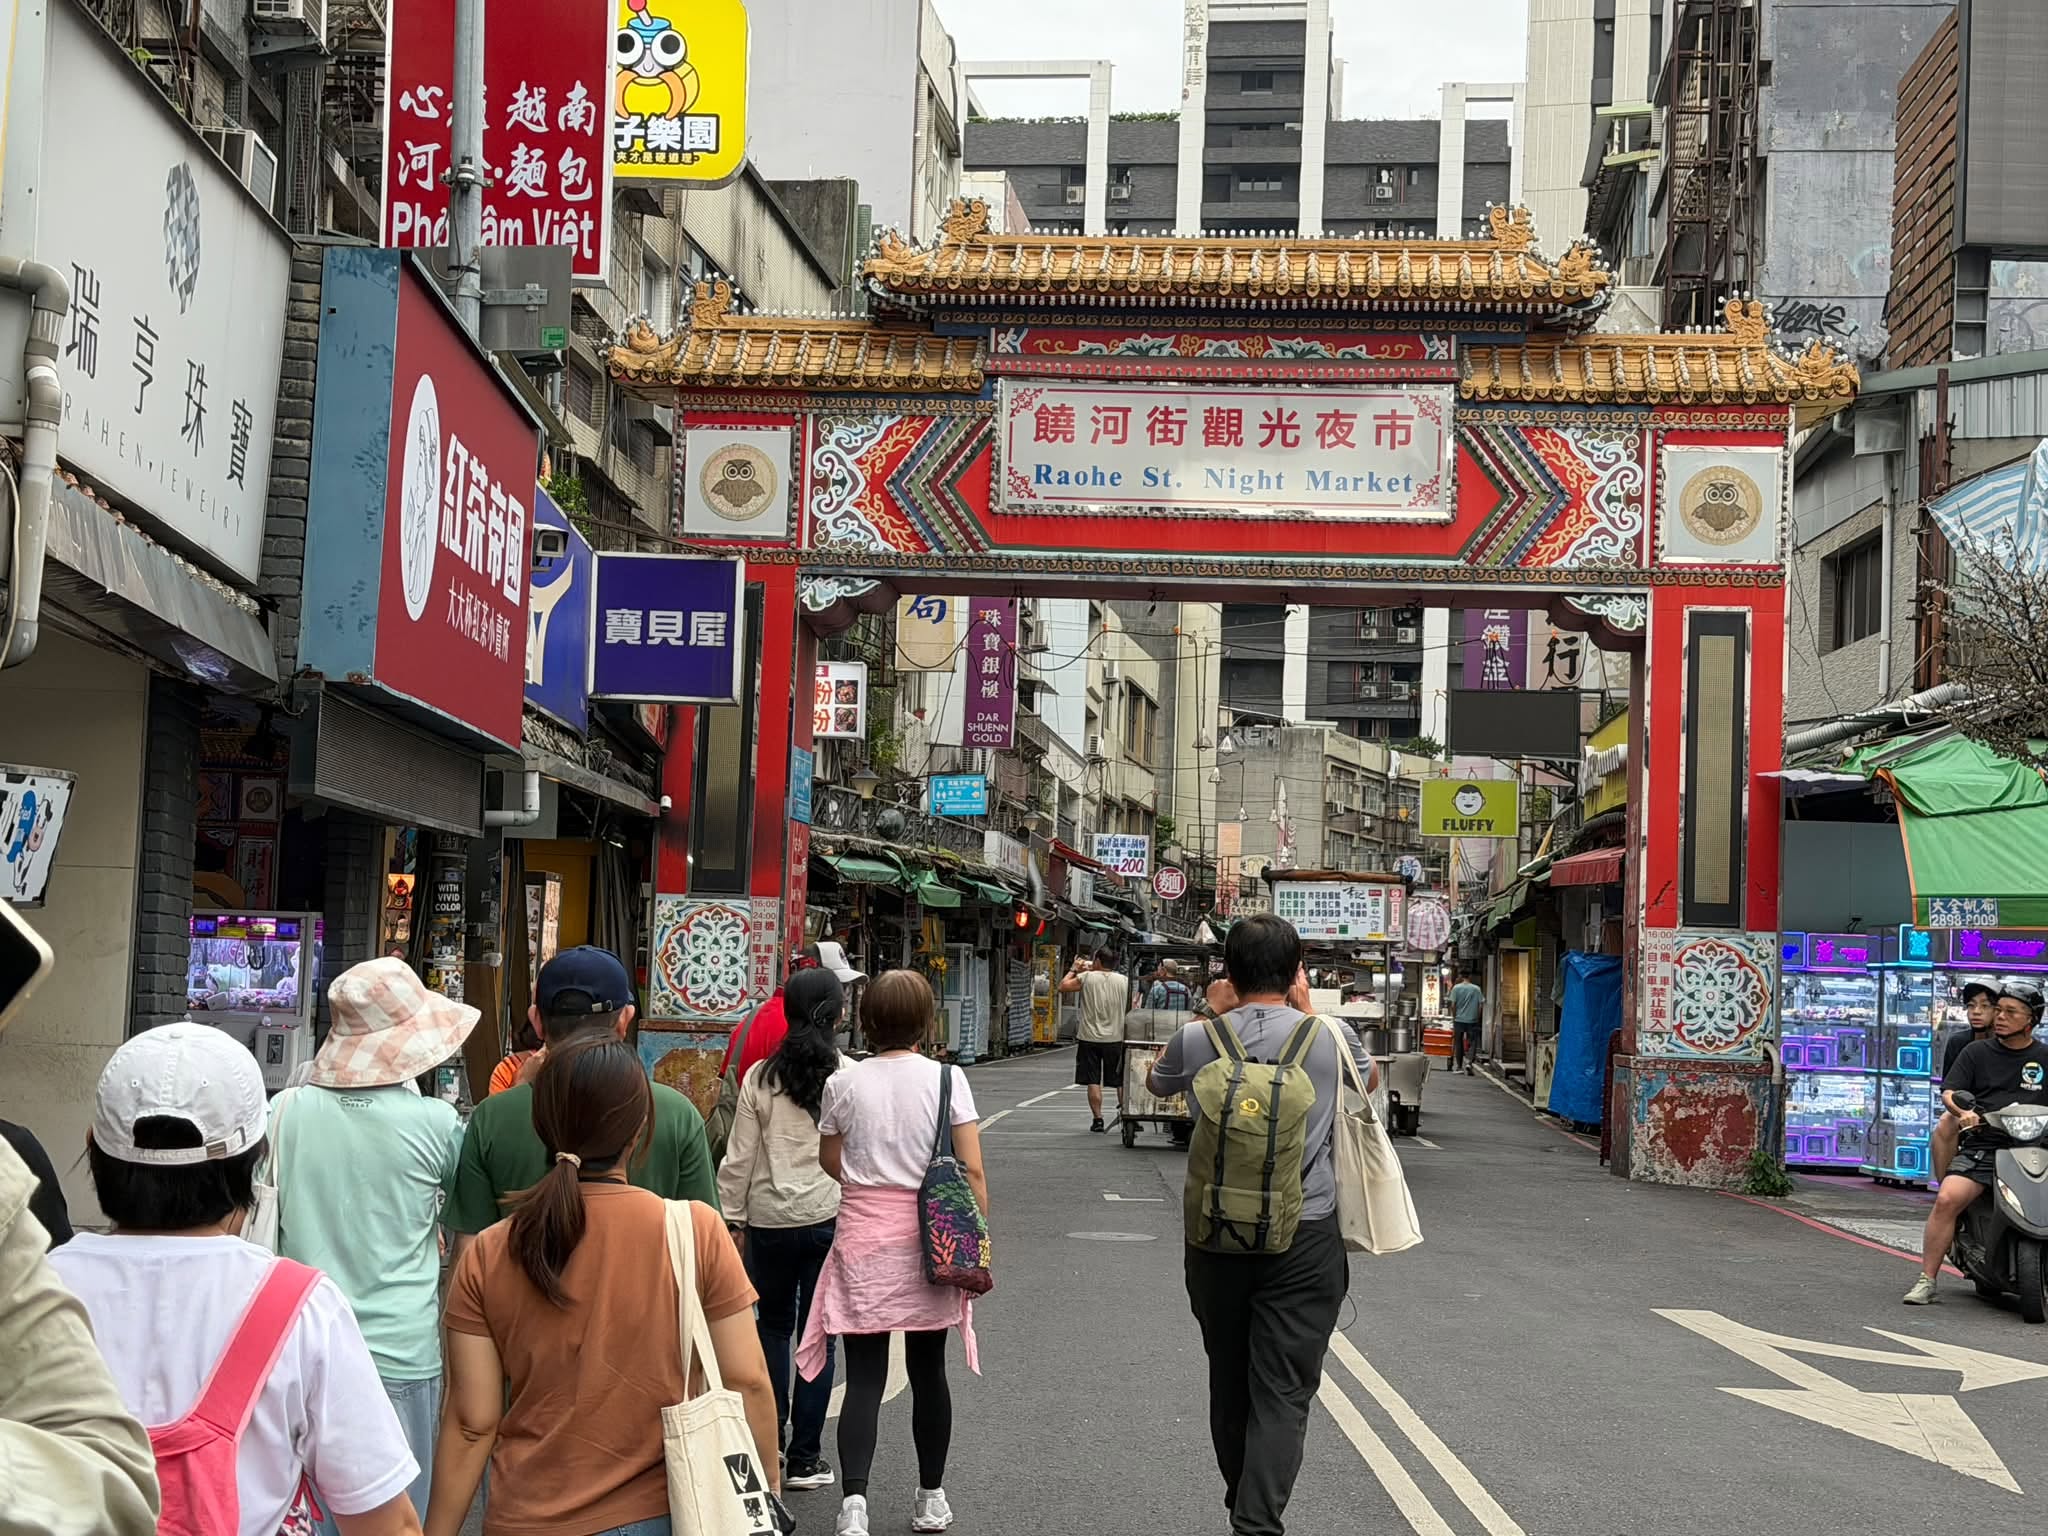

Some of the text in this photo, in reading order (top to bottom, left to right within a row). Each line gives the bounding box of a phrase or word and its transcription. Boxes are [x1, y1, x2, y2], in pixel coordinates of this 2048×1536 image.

[399, 80, 597, 136] 心越南
[482, 205, 524, 248] âm
[1032, 402, 1415, 451] 饒河街觀光夜市
[1033, 463, 1413, 496] Raohe St. Night Market
[441, 432, 525, 607] 紅茶帝國
[605, 608, 728, 647] 寶貝屋
[977, 712, 999, 722] DAR
[967, 722, 1009, 733] SHUENN
[972, 732, 1003, 743] GOLD
[1442, 818, 1495, 832] FLUFFY
[1120, 858, 1144, 873] 200
[438, 883, 459, 893] WITH
[437, 893, 460, 902] VIVID
[434, 903, 461, 912] COLOR
